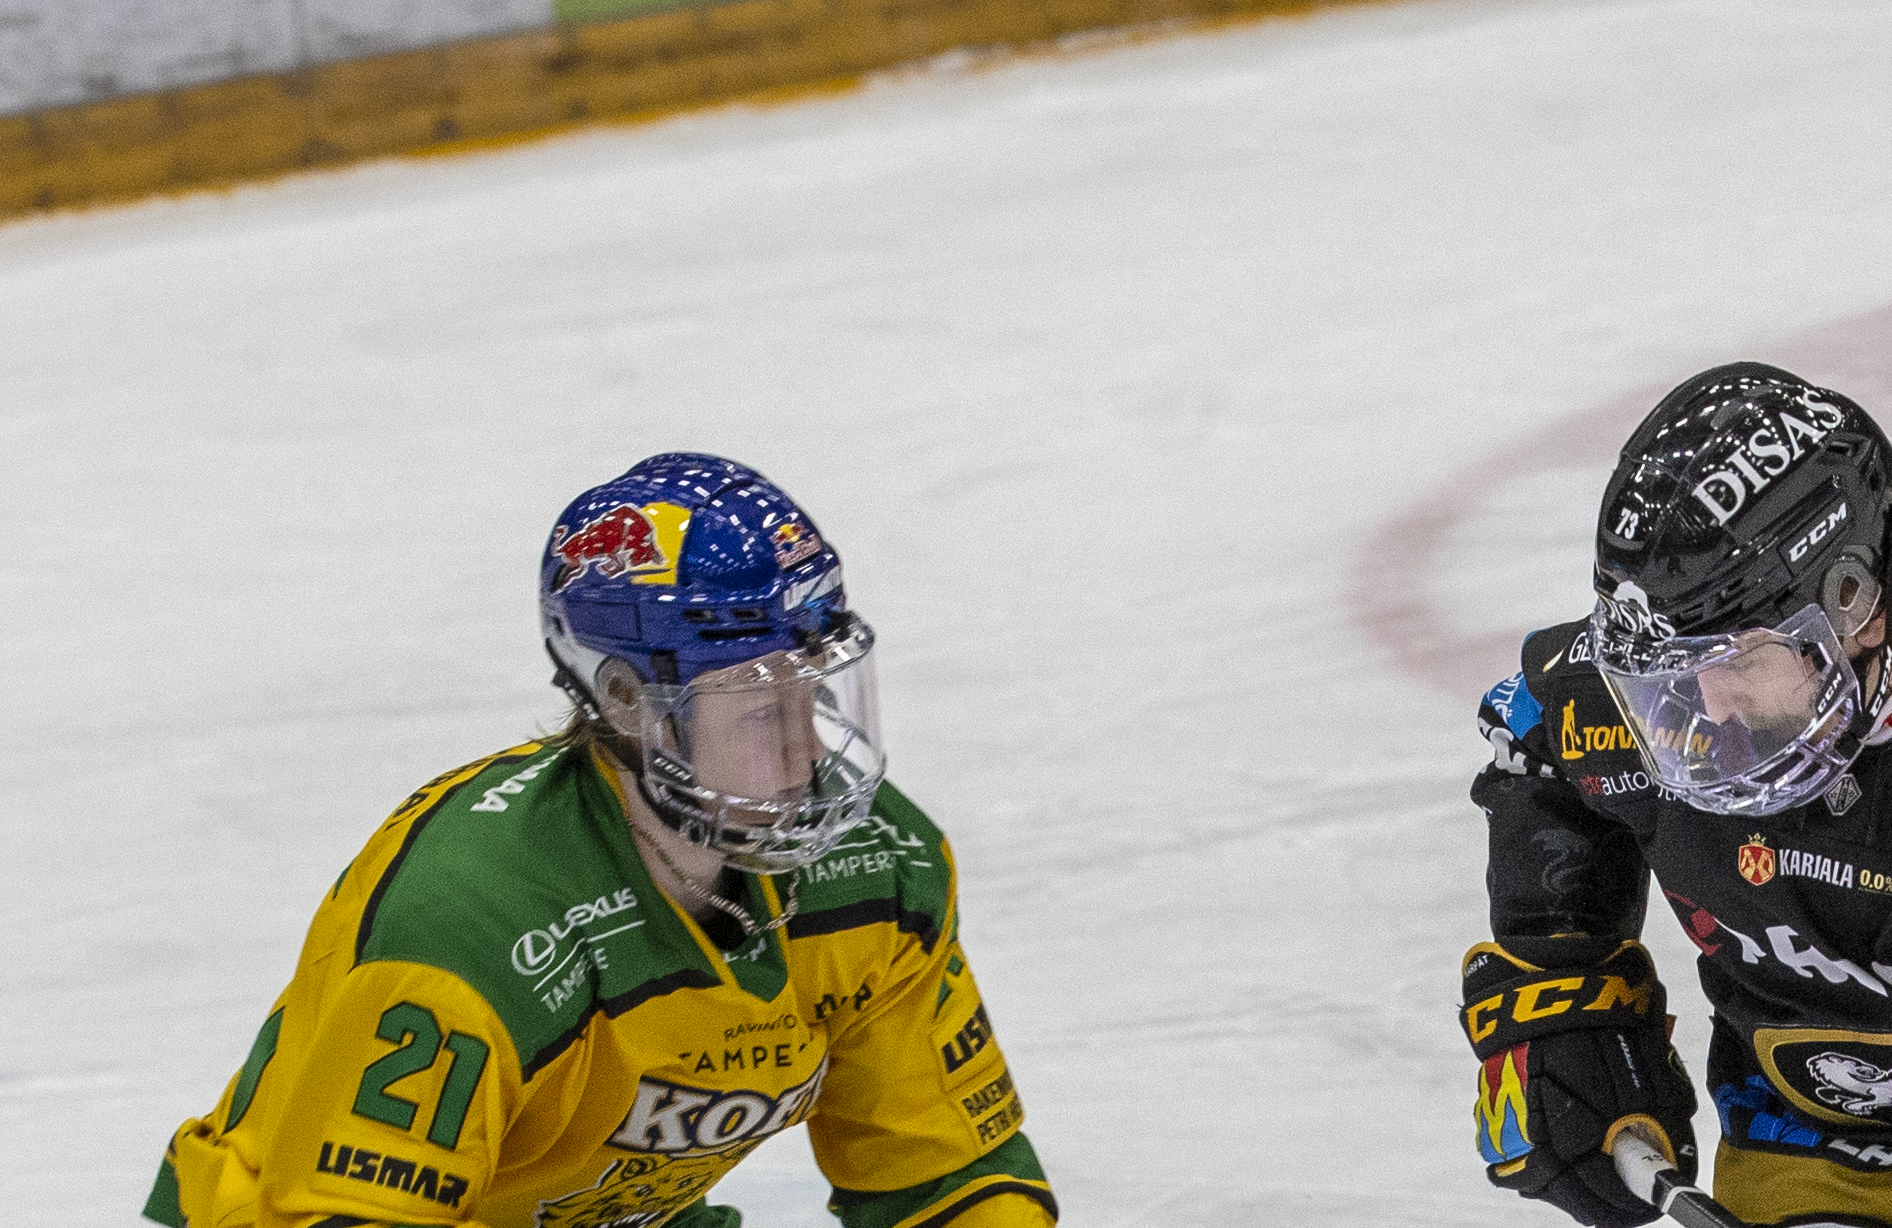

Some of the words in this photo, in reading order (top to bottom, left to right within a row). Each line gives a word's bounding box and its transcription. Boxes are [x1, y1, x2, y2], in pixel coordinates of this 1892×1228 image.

[1692, 388, 1844, 527] DISAS
[1614, 507, 1640, 541] 73
[1787, 502, 1848, 564] CCM
[1816, 671, 1843, 714] CCM
[1779, 848, 1854, 890] KARJALA
[548, 886, 638, 940] LEXUS
[1465, 975, 1650, 1044] CCM
[351, 999, 491, 1152] 21
